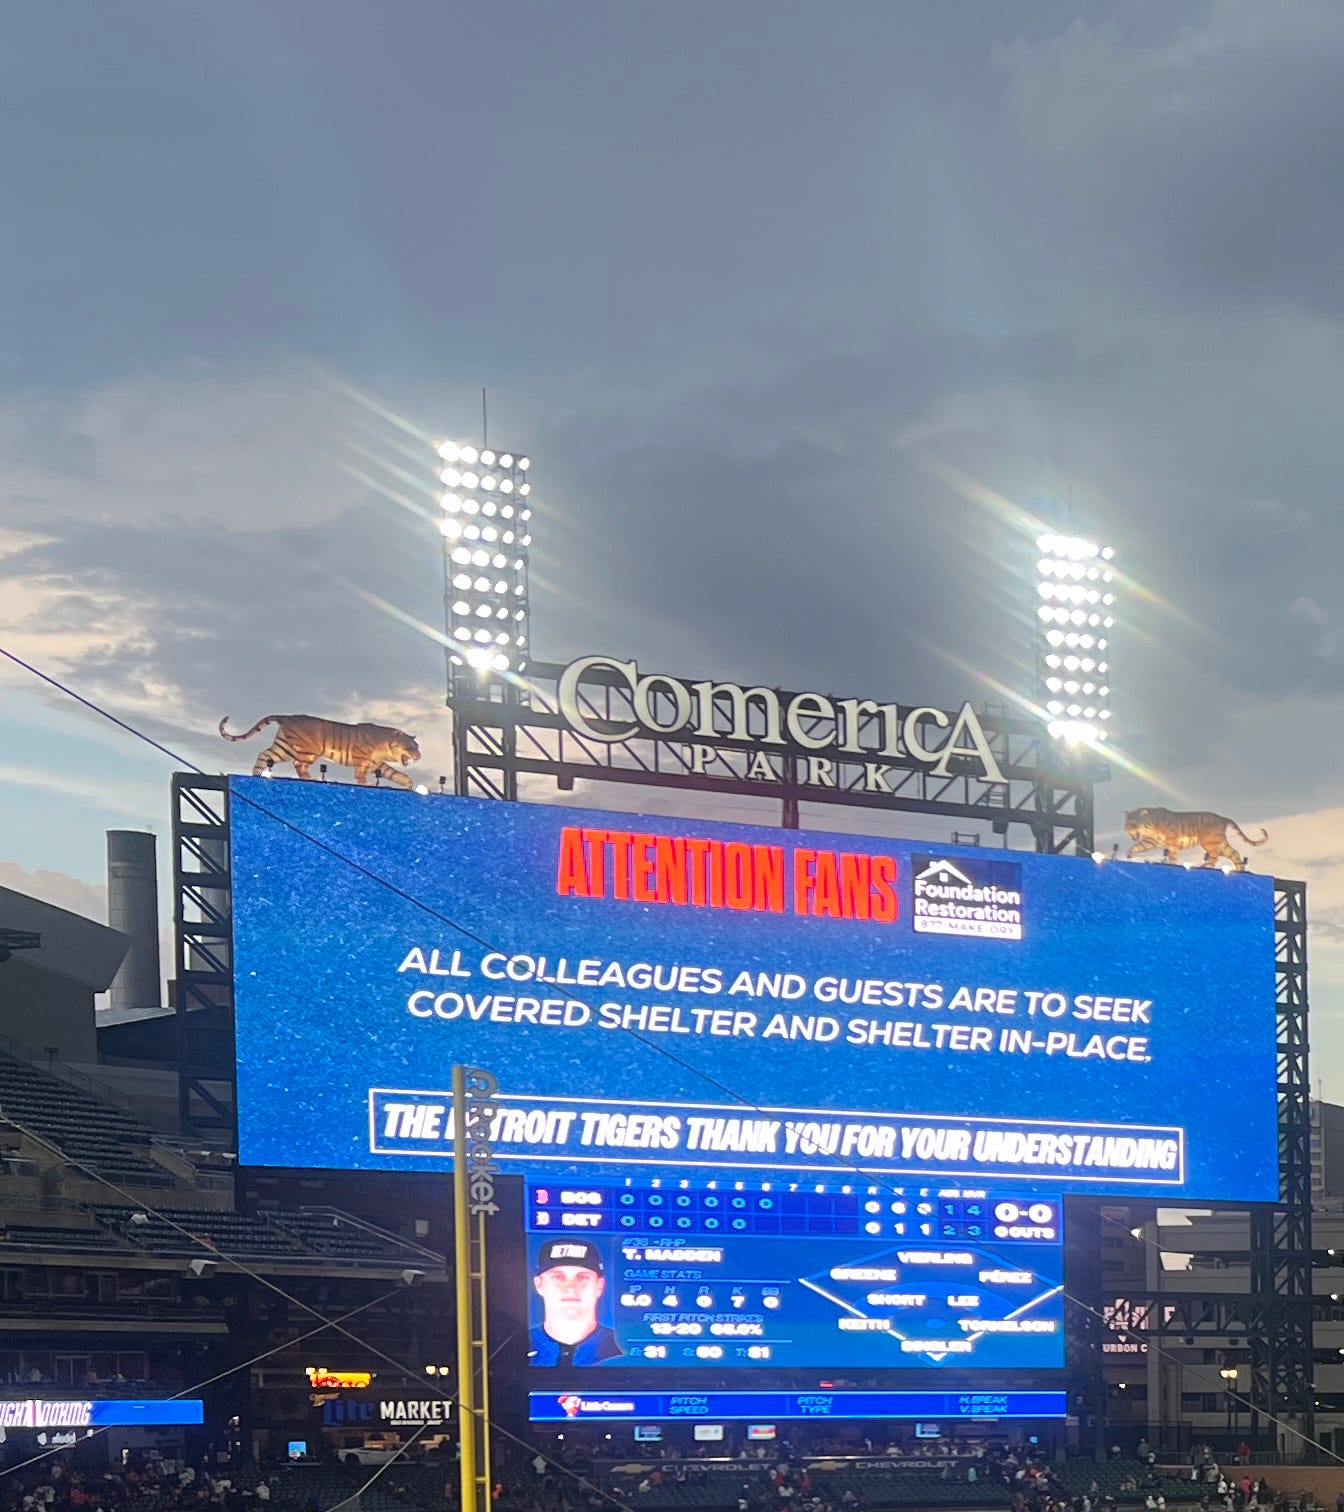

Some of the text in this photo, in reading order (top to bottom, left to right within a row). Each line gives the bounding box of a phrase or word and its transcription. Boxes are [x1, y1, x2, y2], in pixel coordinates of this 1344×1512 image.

[694, 745, 894, 793] PARK
[557, 826, 898, 922] ATTENTION FANS
[915, 879, 1020, 905] Foundation
[915, 898, 1020, 923] Restoration
[398, 947, 1152, 1024] ALL COLLEAGUES AND GUESTS ARE TO SEEK
[407, 991, 1152, 1063] COVERED SHELTER AND SHELTER IN-PLACE.
[383, 1103, 1178, 1170] THE TIGERS THANK YOU FOR YOUR UNDERSTANDING
[469, 1101, 500, 1216] Rocket
[994, 1202, 1052, 1223] 0-0
[1010, 1227, 1054, 1239] OUTS
[322, 1399, 375, 1426] Lite
[380, 1400, 453, 1420] MARKET
